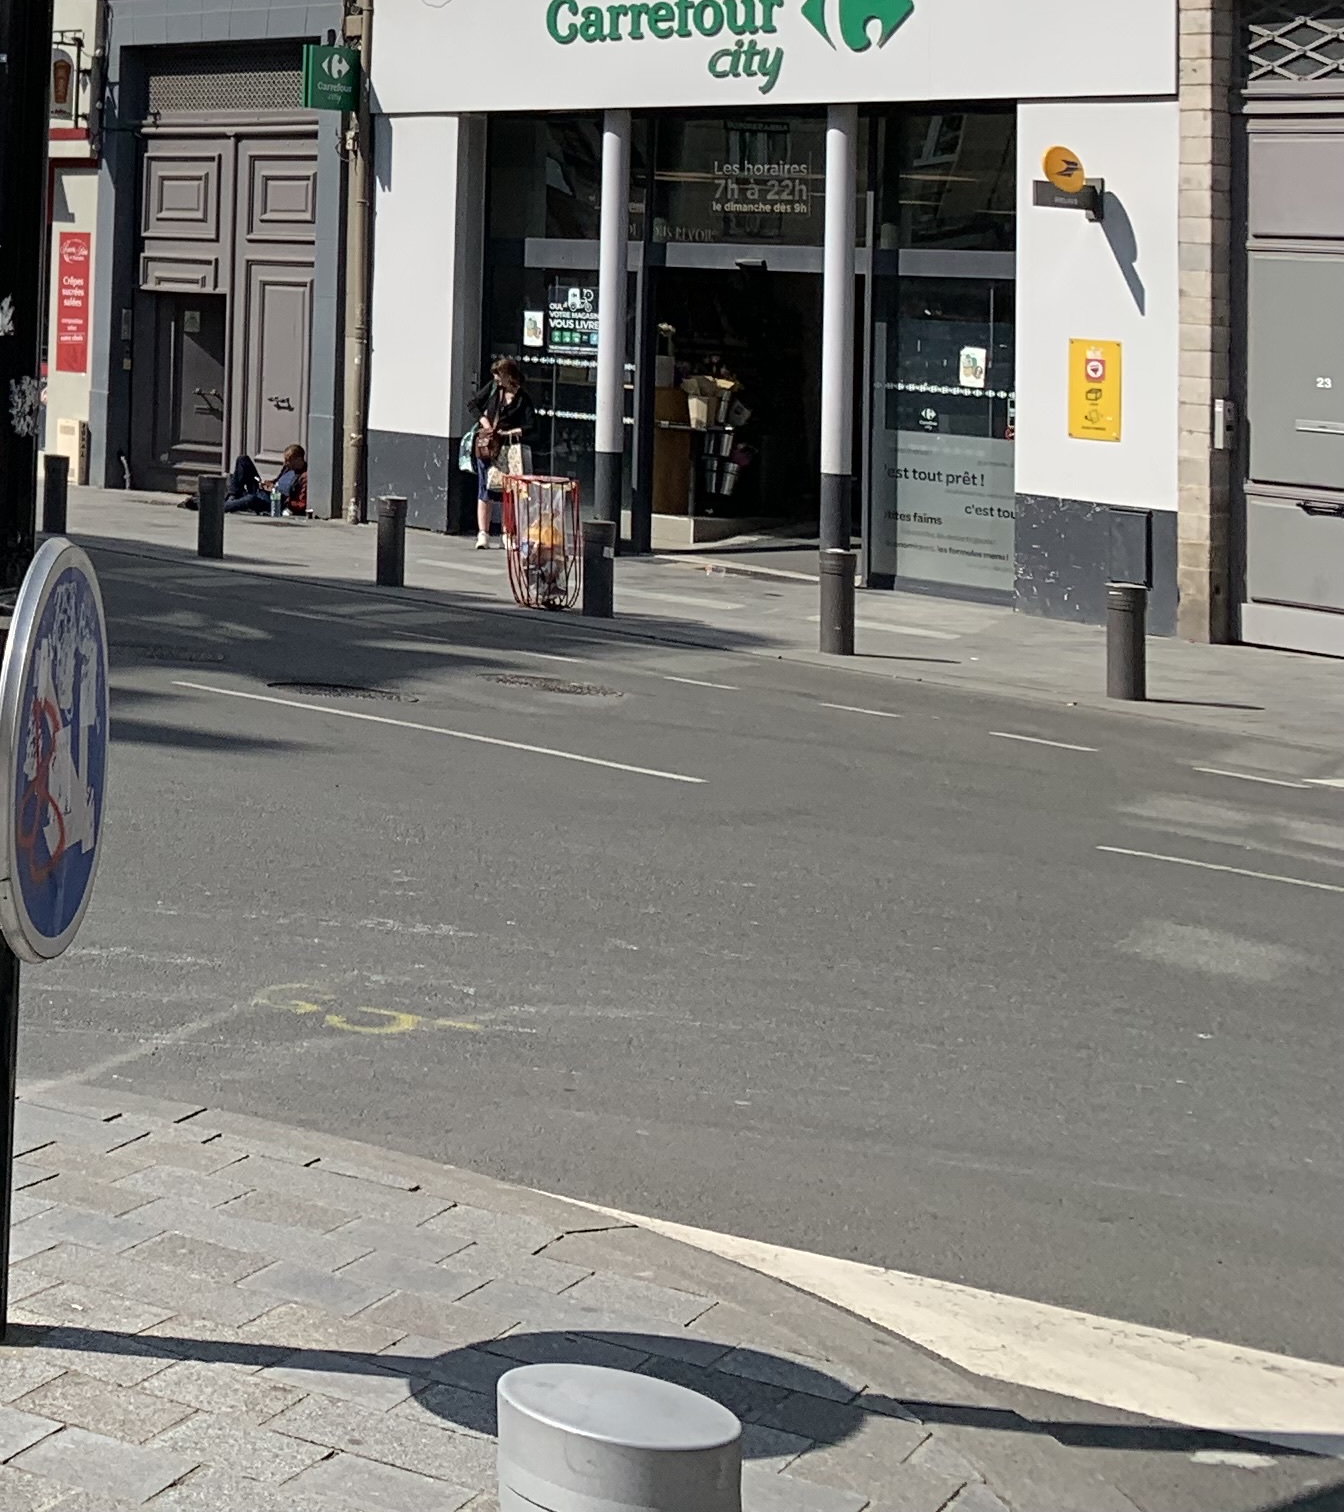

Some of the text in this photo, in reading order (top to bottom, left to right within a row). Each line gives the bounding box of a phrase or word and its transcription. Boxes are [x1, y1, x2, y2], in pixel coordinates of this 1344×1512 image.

[708, 38, 785, 95] city
[713, 160, 808, 177] Les horaires
[713, 178, 808, 200] 7h à 22h
[712, 201, 808, 214] le dimanche dès 9h
[63, 276, 84, 287] Crêpes
[549, 311, 571, 319] VOTRE
[549, 318, 574, 329] VOUS
[1316, 377, 1332, 388] 23
[913, 467, 943, 483] tout
[945, 471, 978, 486] prêt
[965, 504, 994, 517] c'est
[913, 512, 943, 525] faims
